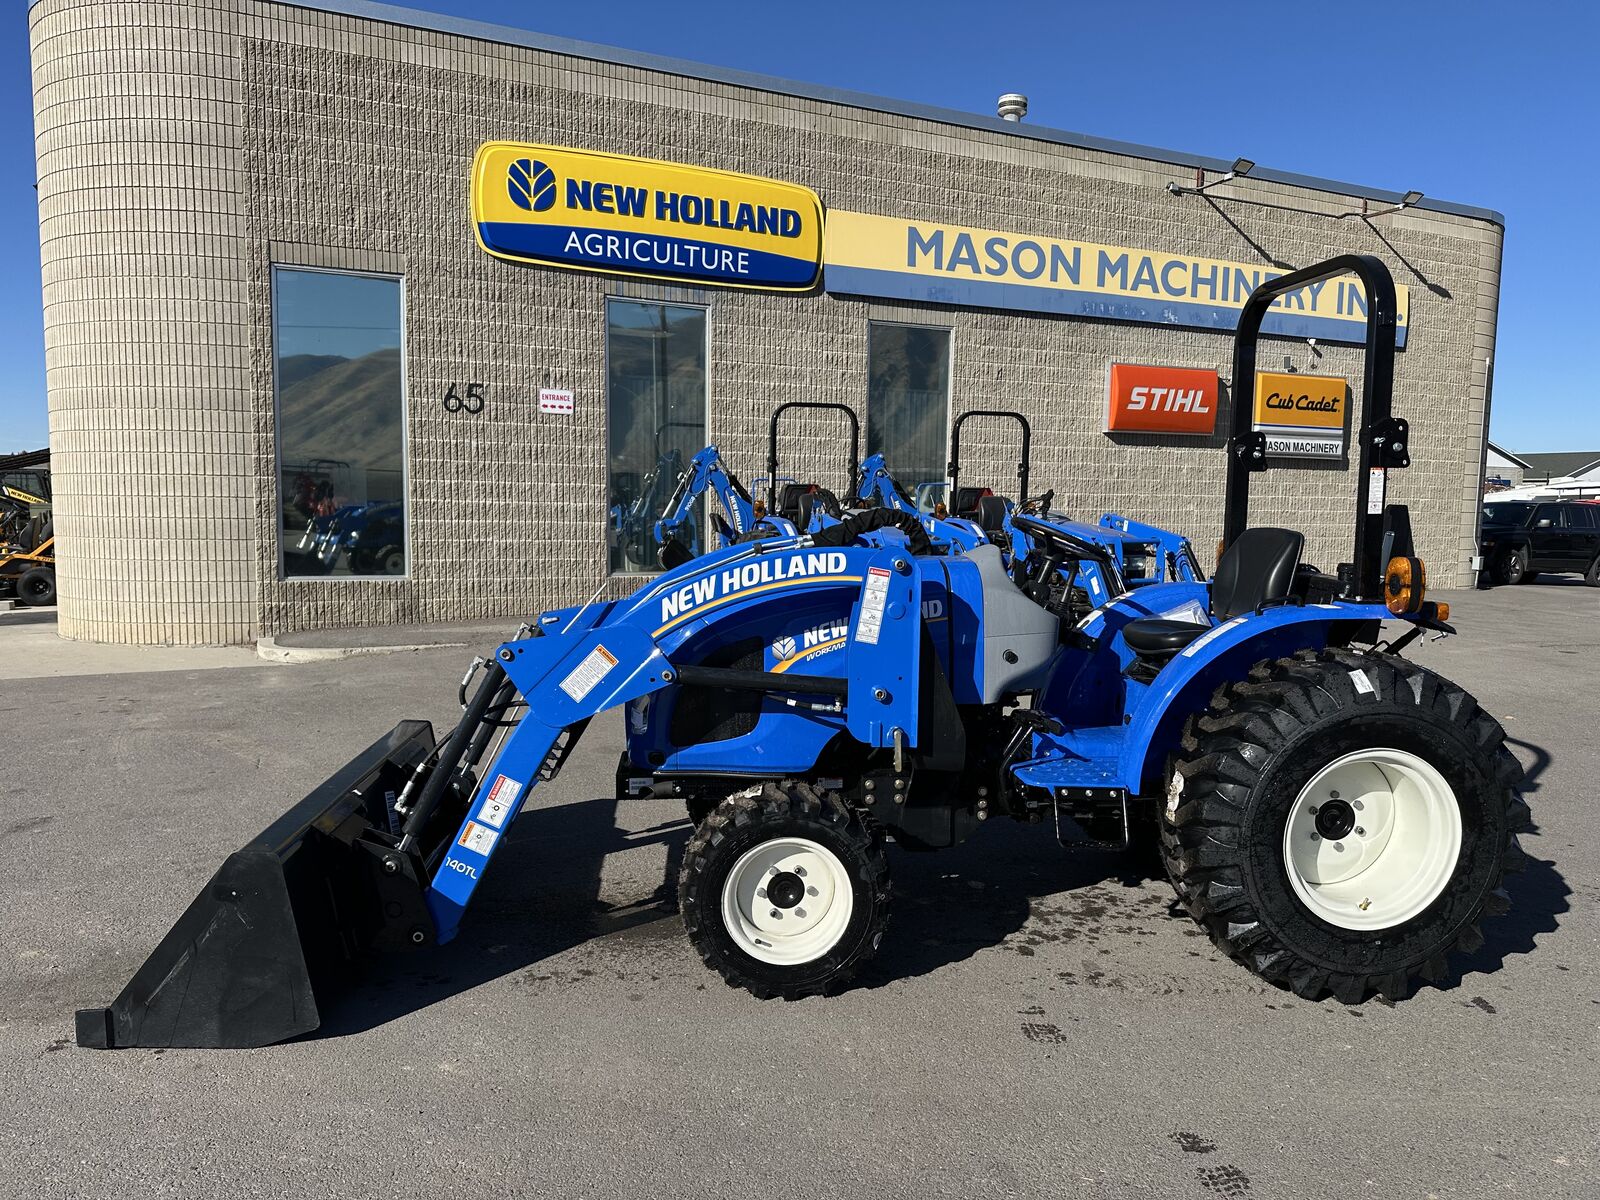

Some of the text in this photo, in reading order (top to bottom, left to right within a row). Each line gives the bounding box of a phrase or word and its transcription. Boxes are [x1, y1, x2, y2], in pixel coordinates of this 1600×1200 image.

[566, 178, 802, 238] NEW HOLLAND
[565, 231, 749, 274] AGRICULTURE
[907, 226, 1081, 285] MASON
[1337, 281, 1403, 321] IN.
[443, 382, 485, 414] 65
[541, 393, 571, 402] ENTRANCE
[1127, 386, 1210, 414] STIHL
[1266, 392, 1340, 413] Cub Cadet
[1292, 442, 1340, 454] MACHINERY
[730, 495, 739, 512] NEW
[661, 552, 847, 623] NEW HOLLAND
[803, 616, 849, 649] NEW
[445, 857, 477, 879] 140TL
